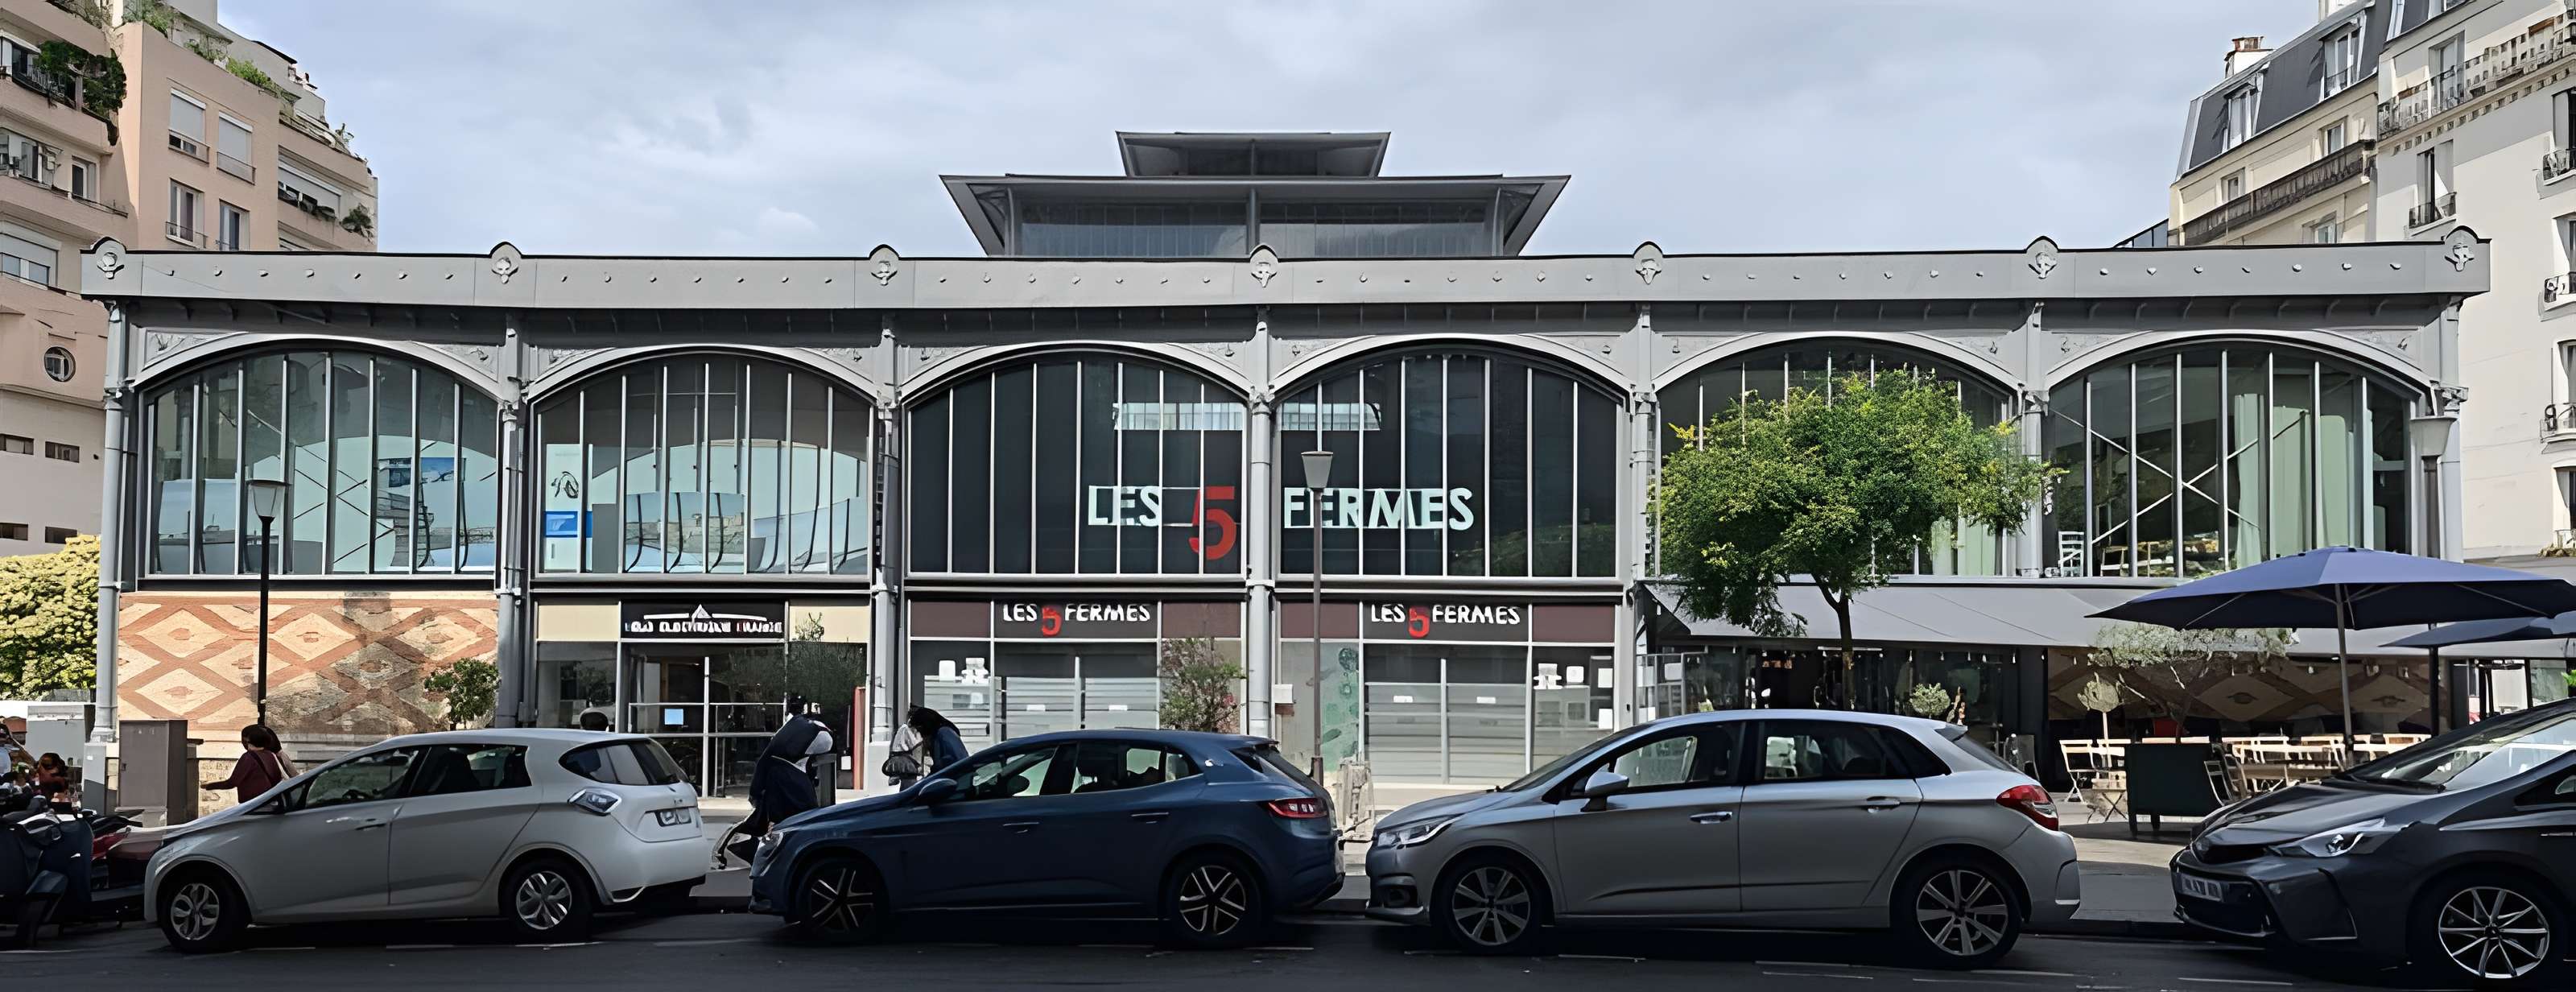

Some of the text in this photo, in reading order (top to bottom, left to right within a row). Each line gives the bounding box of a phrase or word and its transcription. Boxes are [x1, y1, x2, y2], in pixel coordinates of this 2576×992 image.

[1088, 486, 1474, 560] LES 5 FERMES
[1003, 604, 1150, 637] LES 5 FERMES
[1371, 604, 1521, 639] LES 5 FERMES
